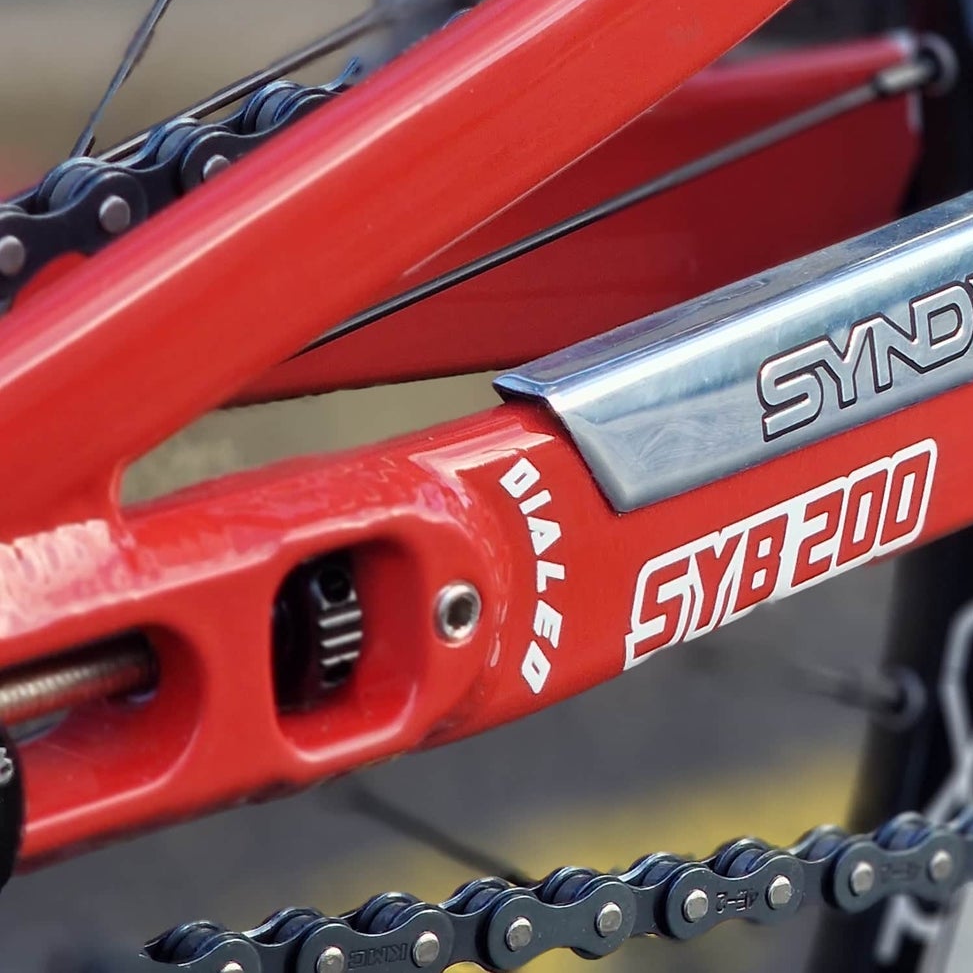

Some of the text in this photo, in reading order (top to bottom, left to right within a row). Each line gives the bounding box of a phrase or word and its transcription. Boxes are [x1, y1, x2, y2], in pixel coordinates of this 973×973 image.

[498, 457, 566, 694] DIALED
[623, 438, 938, 671] SYB200
[348, 942, 409, 971] KMC
